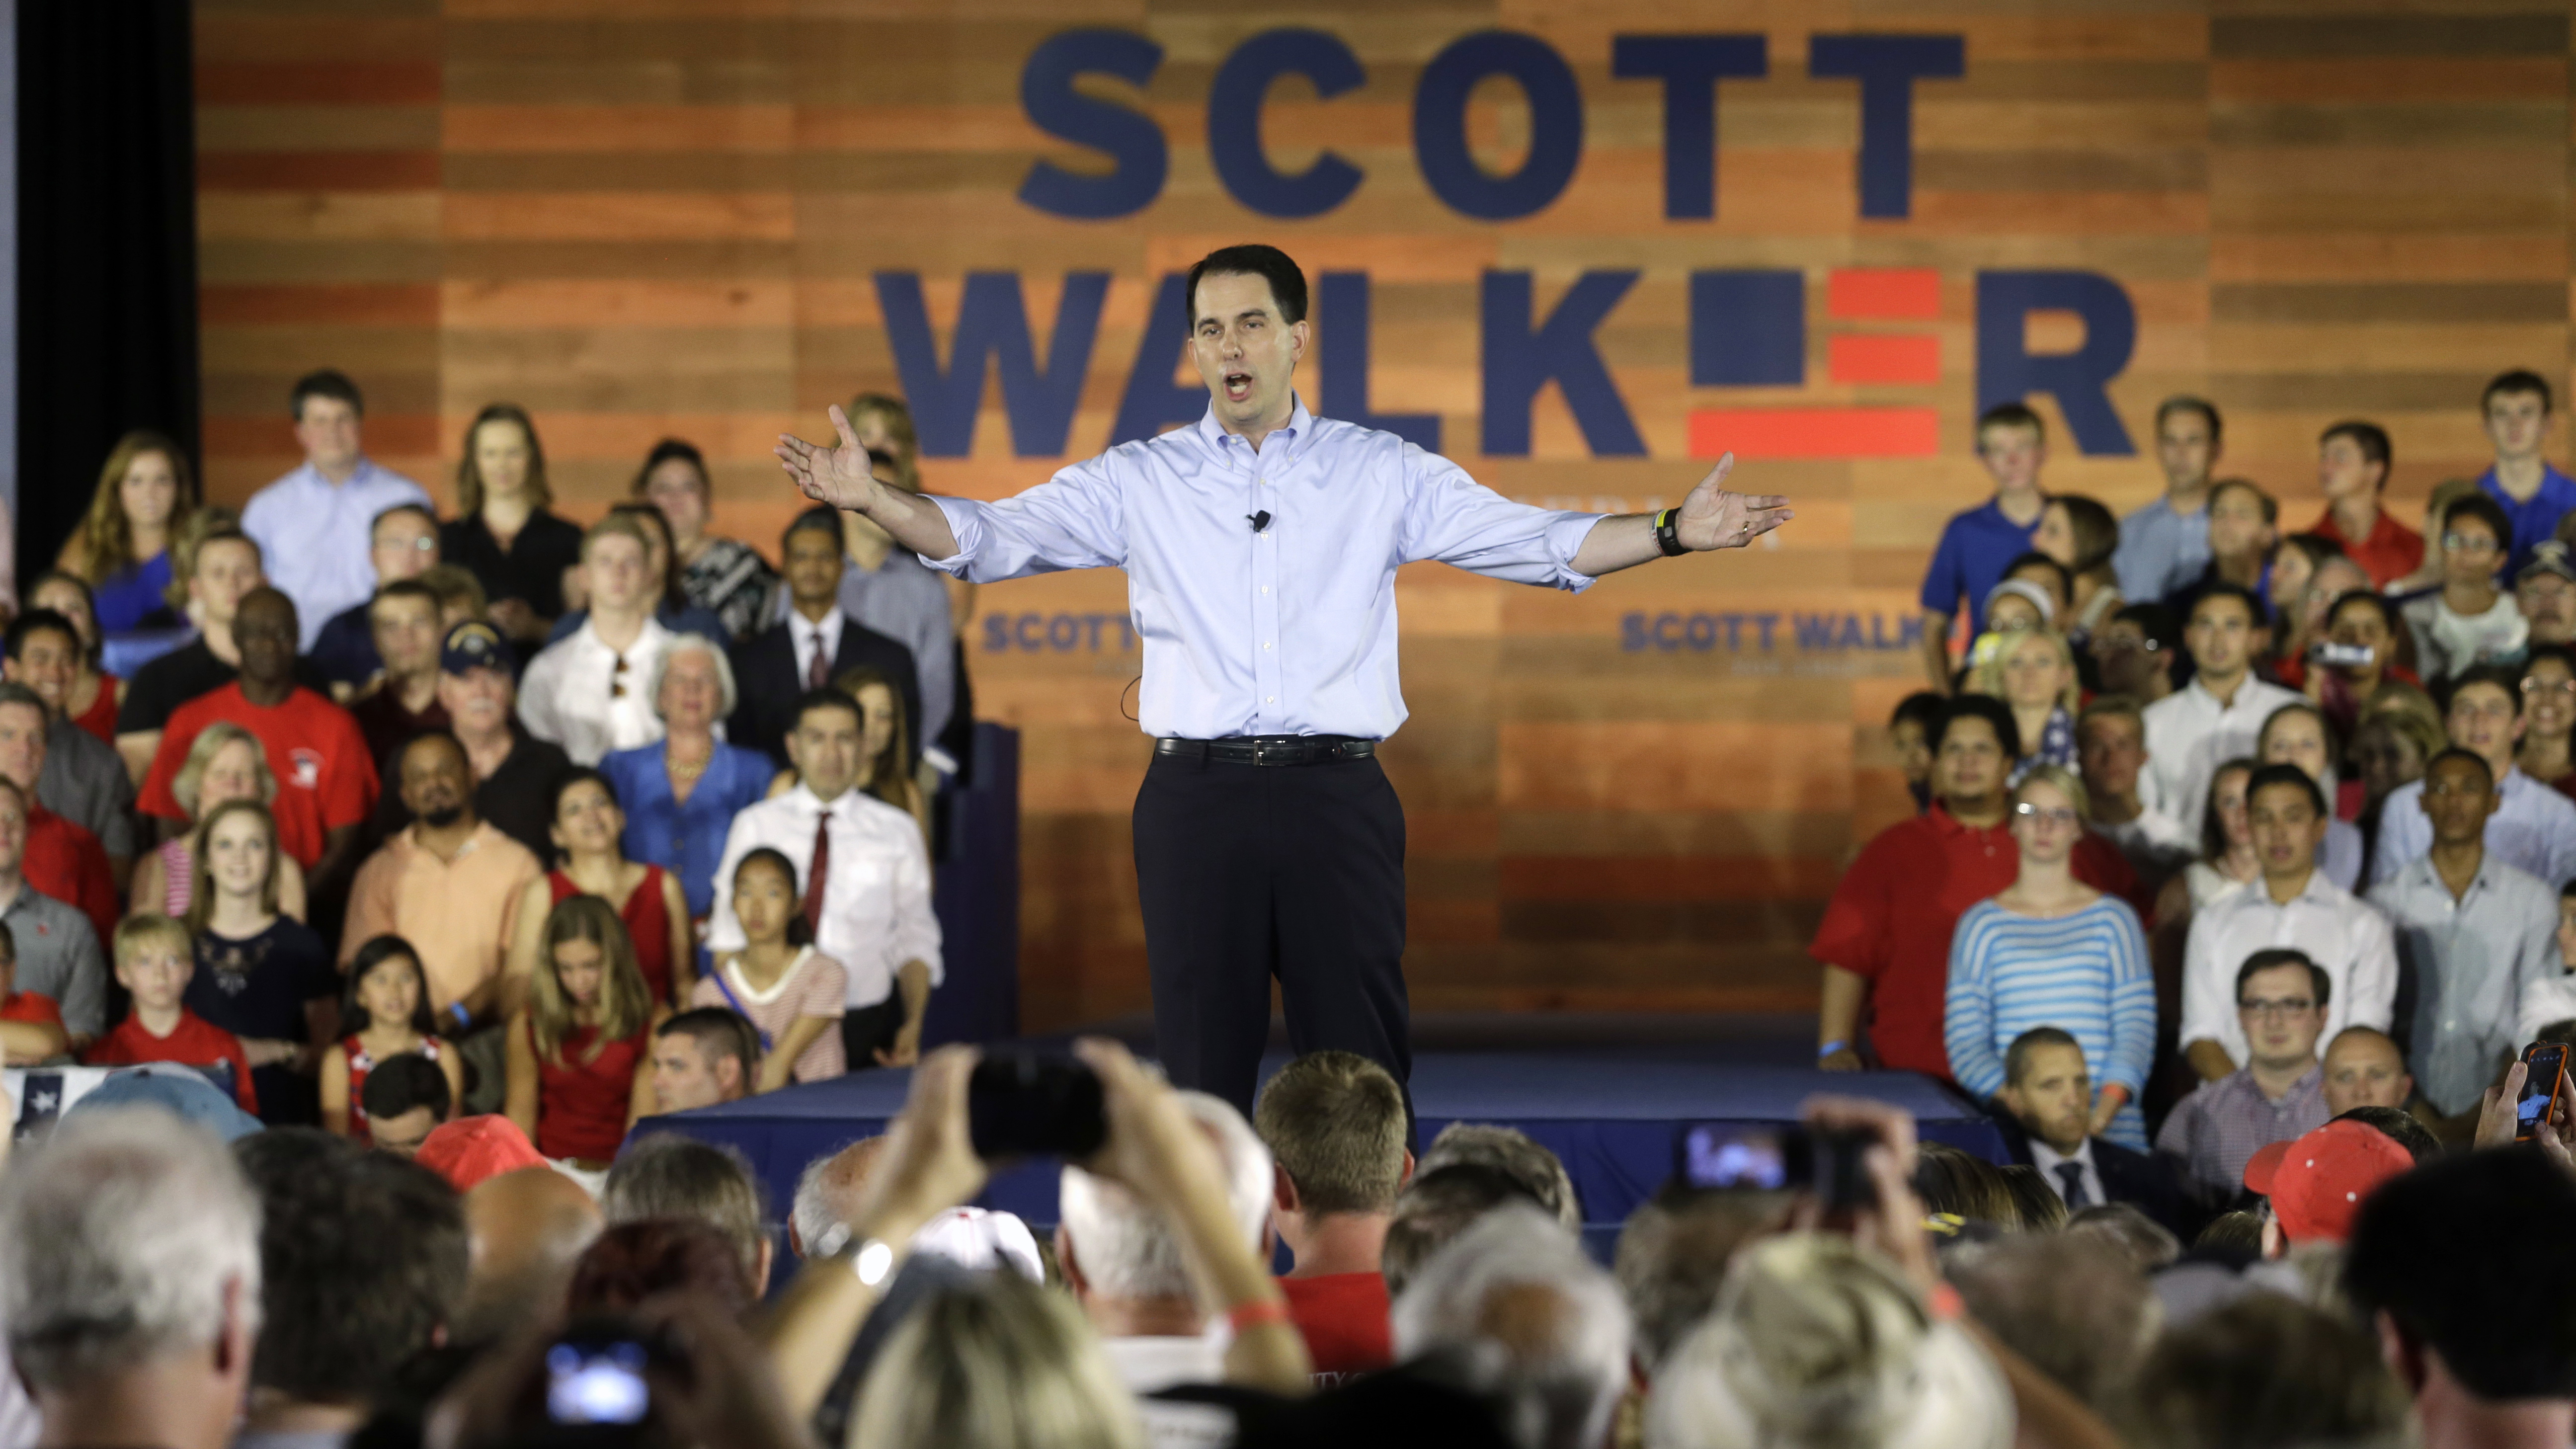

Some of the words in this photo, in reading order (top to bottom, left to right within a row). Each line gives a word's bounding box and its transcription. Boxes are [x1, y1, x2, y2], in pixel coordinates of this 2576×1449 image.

[1017, 27, 1966, 222] SCOTT
[982, 612, 1134, 653] SCOTT
[1621, 611, 1779, 654] SCOTT
[1793, 613, 1925, 652] WALK
[1308, 1370, 1346, 1389] ITY
